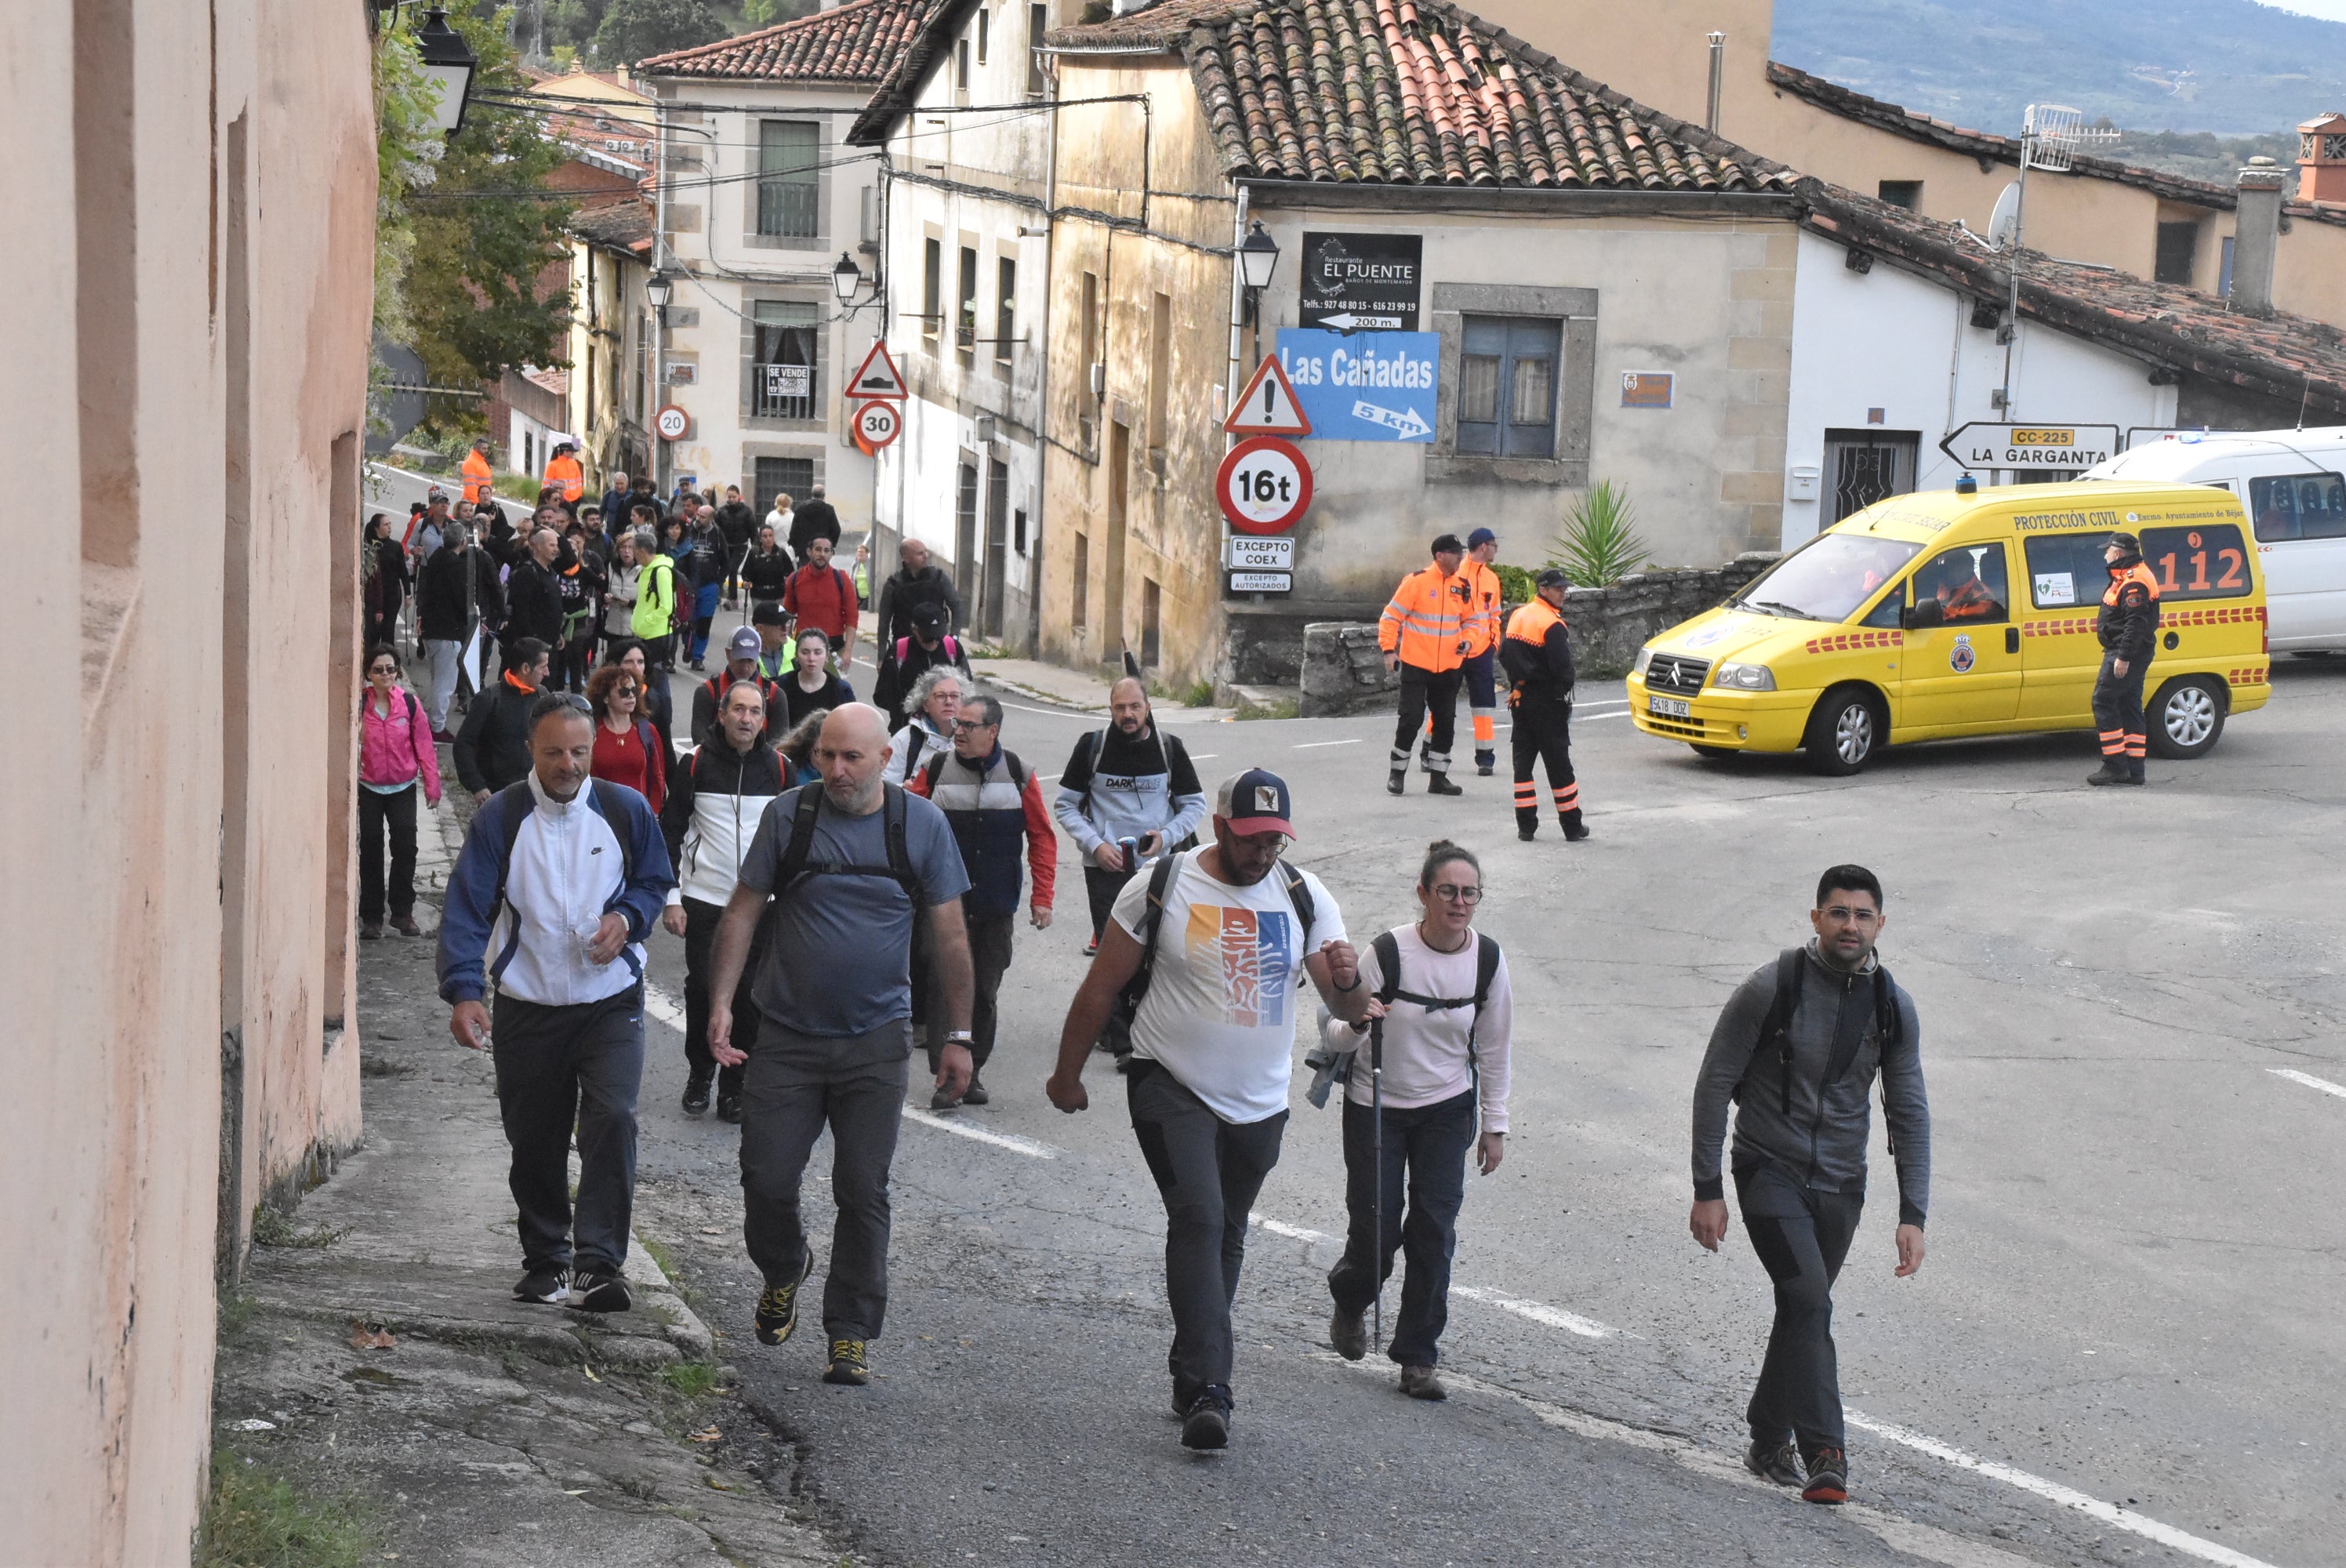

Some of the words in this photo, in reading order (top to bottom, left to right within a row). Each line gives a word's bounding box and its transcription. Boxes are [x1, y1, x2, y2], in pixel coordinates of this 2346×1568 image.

[1324, 256, 1364, 264] Restaurante
[1324, 263, 1342, 277] EL
[1347, 264, 1413, 278] PUENTE
[1302, 299, 1323, 309] Telfs.:
[1324, 300, 1337, 309] 927
[1338, 300, 1347, 310] 48
[1348, 301, 1357, 310] 80
[1358, 301, 1367, 310] 15
[1373, 302, 1385, 310] 616
[1387, 302, 1396, 311] 23
[1397, 303, 1406, 311] 99
[1407, 303, 1416, 312] 19
[1355, 318, 1377, 327] 200
[769, 368, 780, 377] SE
[781, 368, 807, 378] VENDE
[1282, 347, 1323, 385] Las
[1331, 348, 1433, 389] Cañadas
[663, 416, 681, 430] 20
[865, 416, 891, 432] 30
[1359, 406, 1374, 419] 5
[1383, 412, 1422, 434] km
[2016, 431, 2069, 443] CC-225
[1972, 448, 1993, 462] LA
[2005, 449, 2108, 464] GARGANTA
[1237, 469, 1291, 503] 16t
[2013, 510, 2087, 531] PROTECCIÓN
[2089, 511, 2120, 527] CIVIL
[2166, 512, 2214, 522] Ayuntamiento
[2225, 510, 2244, 518] Béjar
[1236, 541, 1290, 553] EXCEPTO
[1245, 554, 1278, 565] COEX
[2159, 548, 2243, 592] 112
[1653, 698, 1669, 712] 5418
[1673, 701, 1687, 715] DDZ
[1105, 778, 1134, 788] DARK
[1278, 914, 1287, 949] SPRINGFIELD
